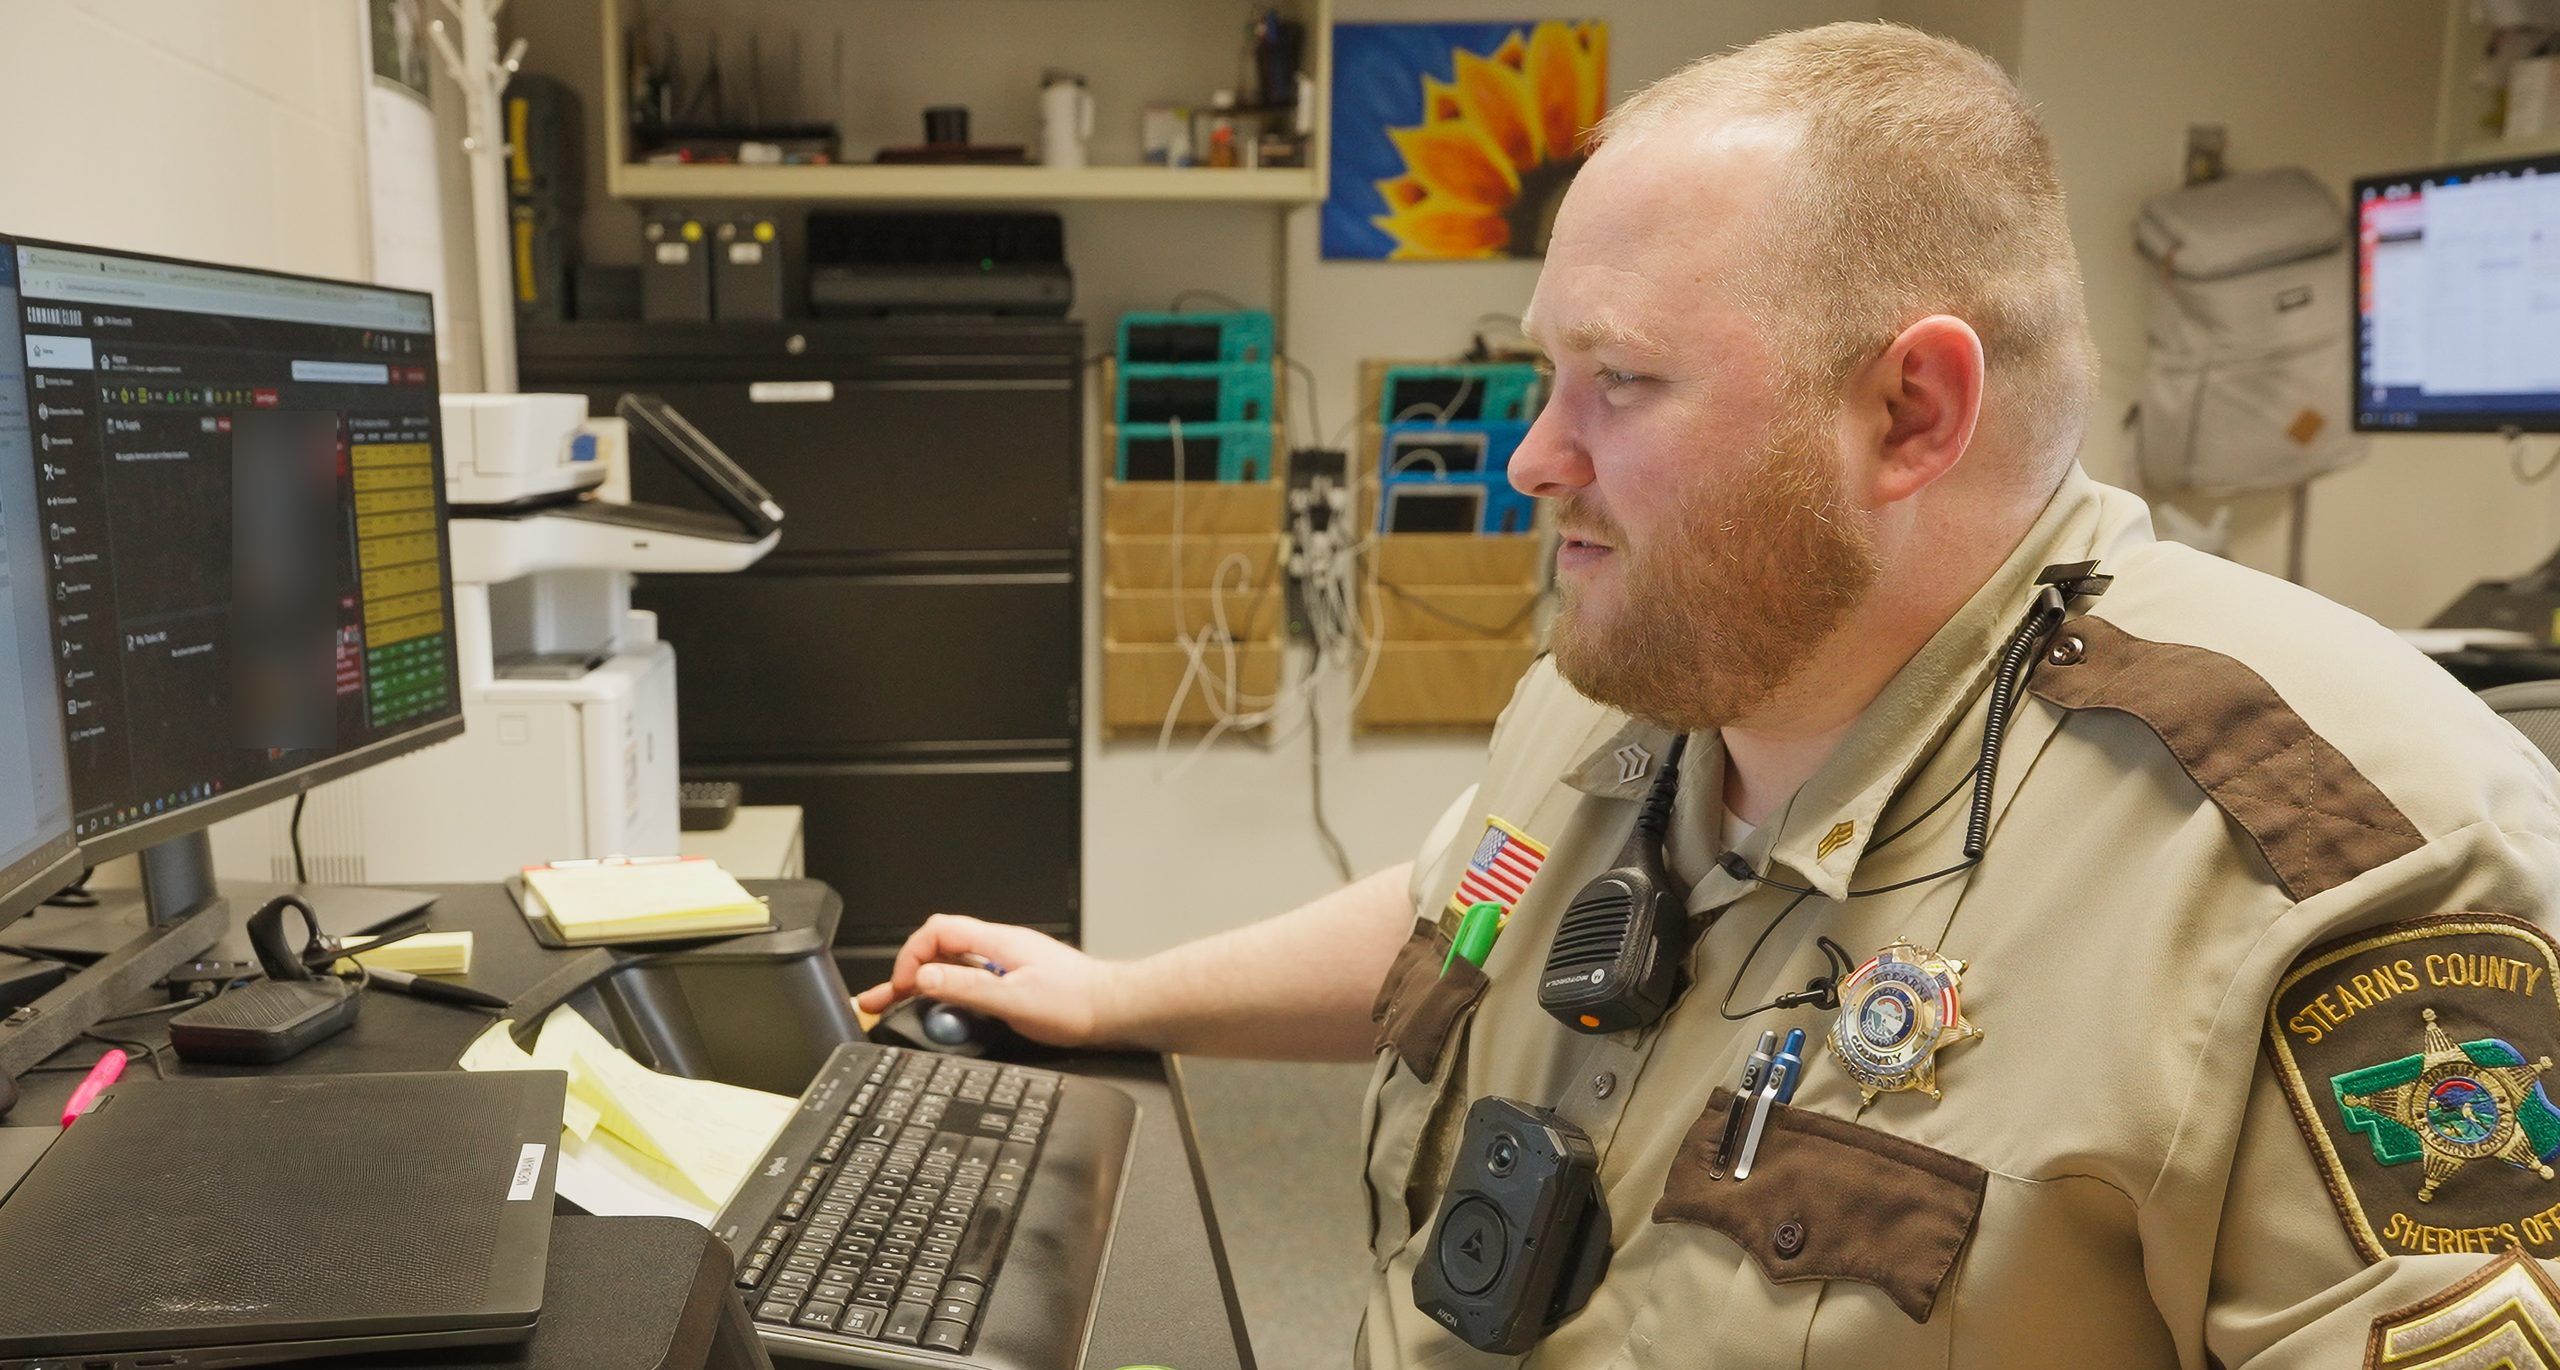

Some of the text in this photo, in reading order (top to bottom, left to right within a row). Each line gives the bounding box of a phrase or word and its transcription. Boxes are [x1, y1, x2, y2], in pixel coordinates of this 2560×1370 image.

[1545, 974, 1589, 988] MOTOROLA
[2289, 952, 2544, 1045] STEARNS COUNTY
[2383, 1212, 2521, 1254] SHERIFF'S
